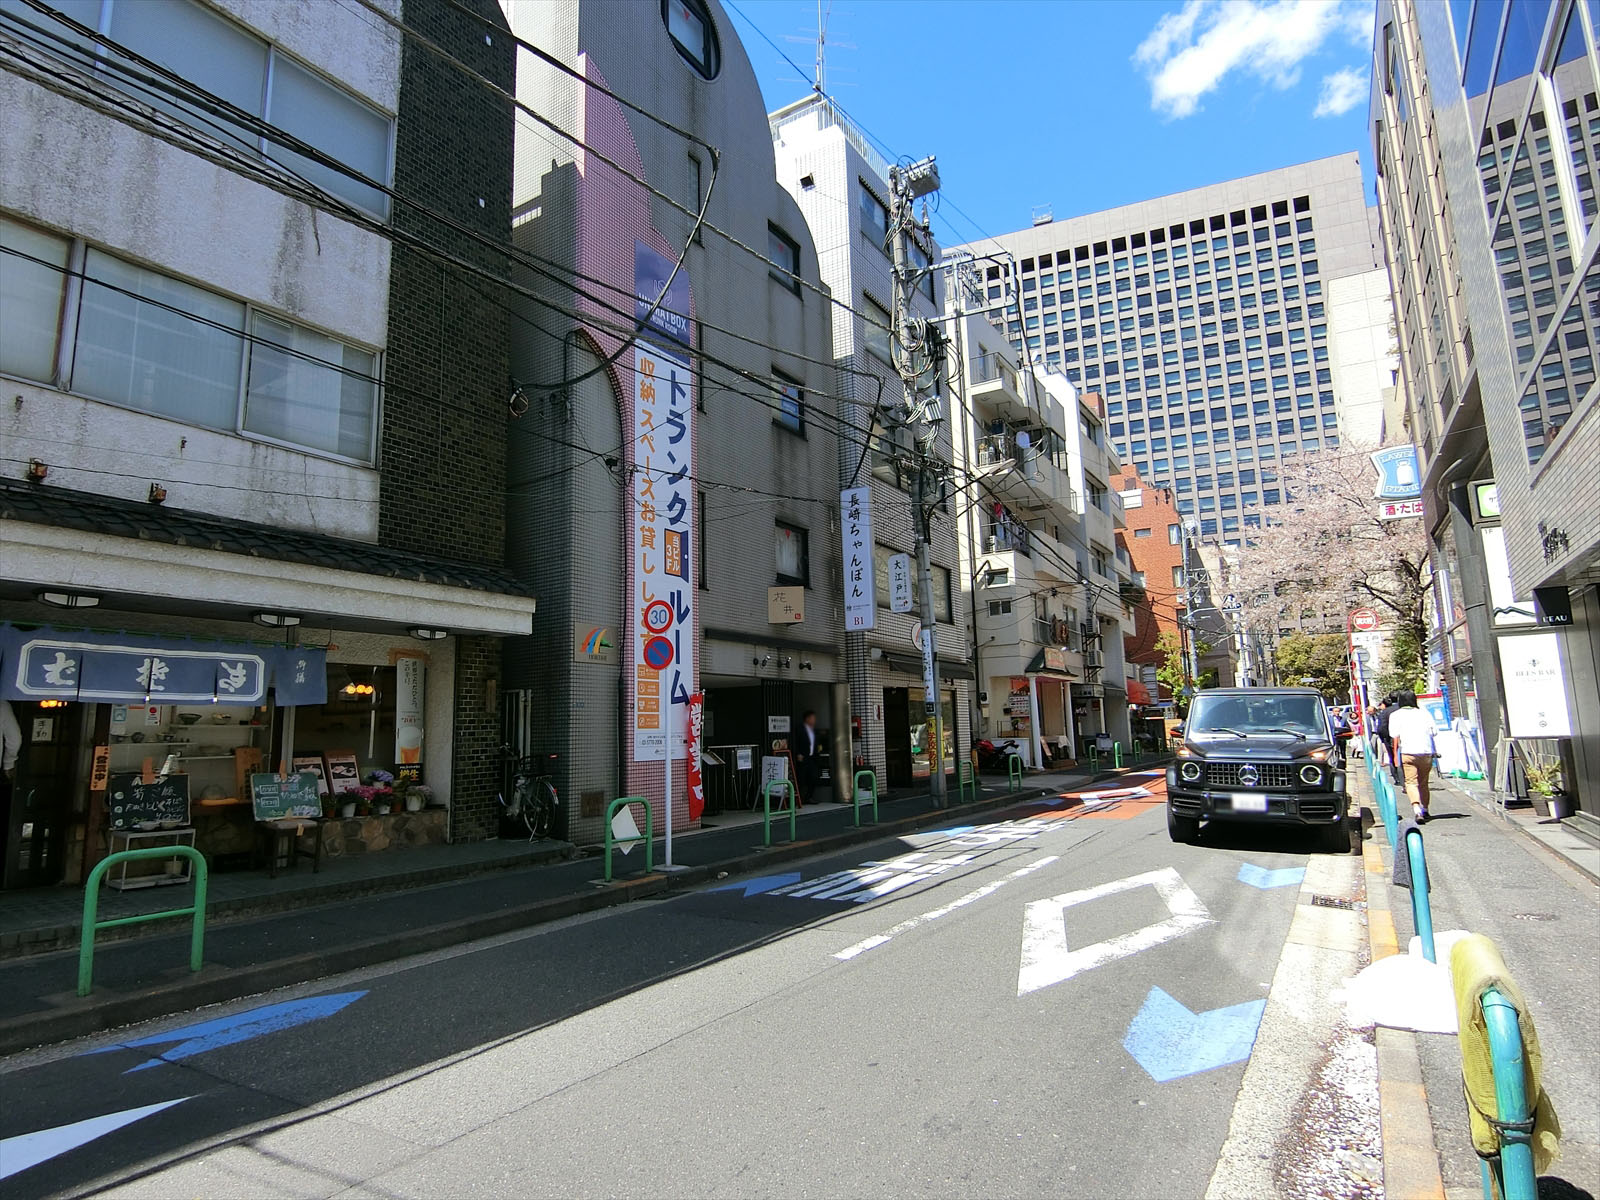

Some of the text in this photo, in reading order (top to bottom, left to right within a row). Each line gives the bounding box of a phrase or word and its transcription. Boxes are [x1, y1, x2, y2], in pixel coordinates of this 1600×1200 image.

[671, 314, 687, 332] BOX
[848, 493, 863, 598] 長崎ちゃんぽん
[666, 544, 672, 570] 3F
[894, 560, 903, 593] 大江戸
[650, 609, 668, 625] 30
[854, 616, 864, 626] B1
